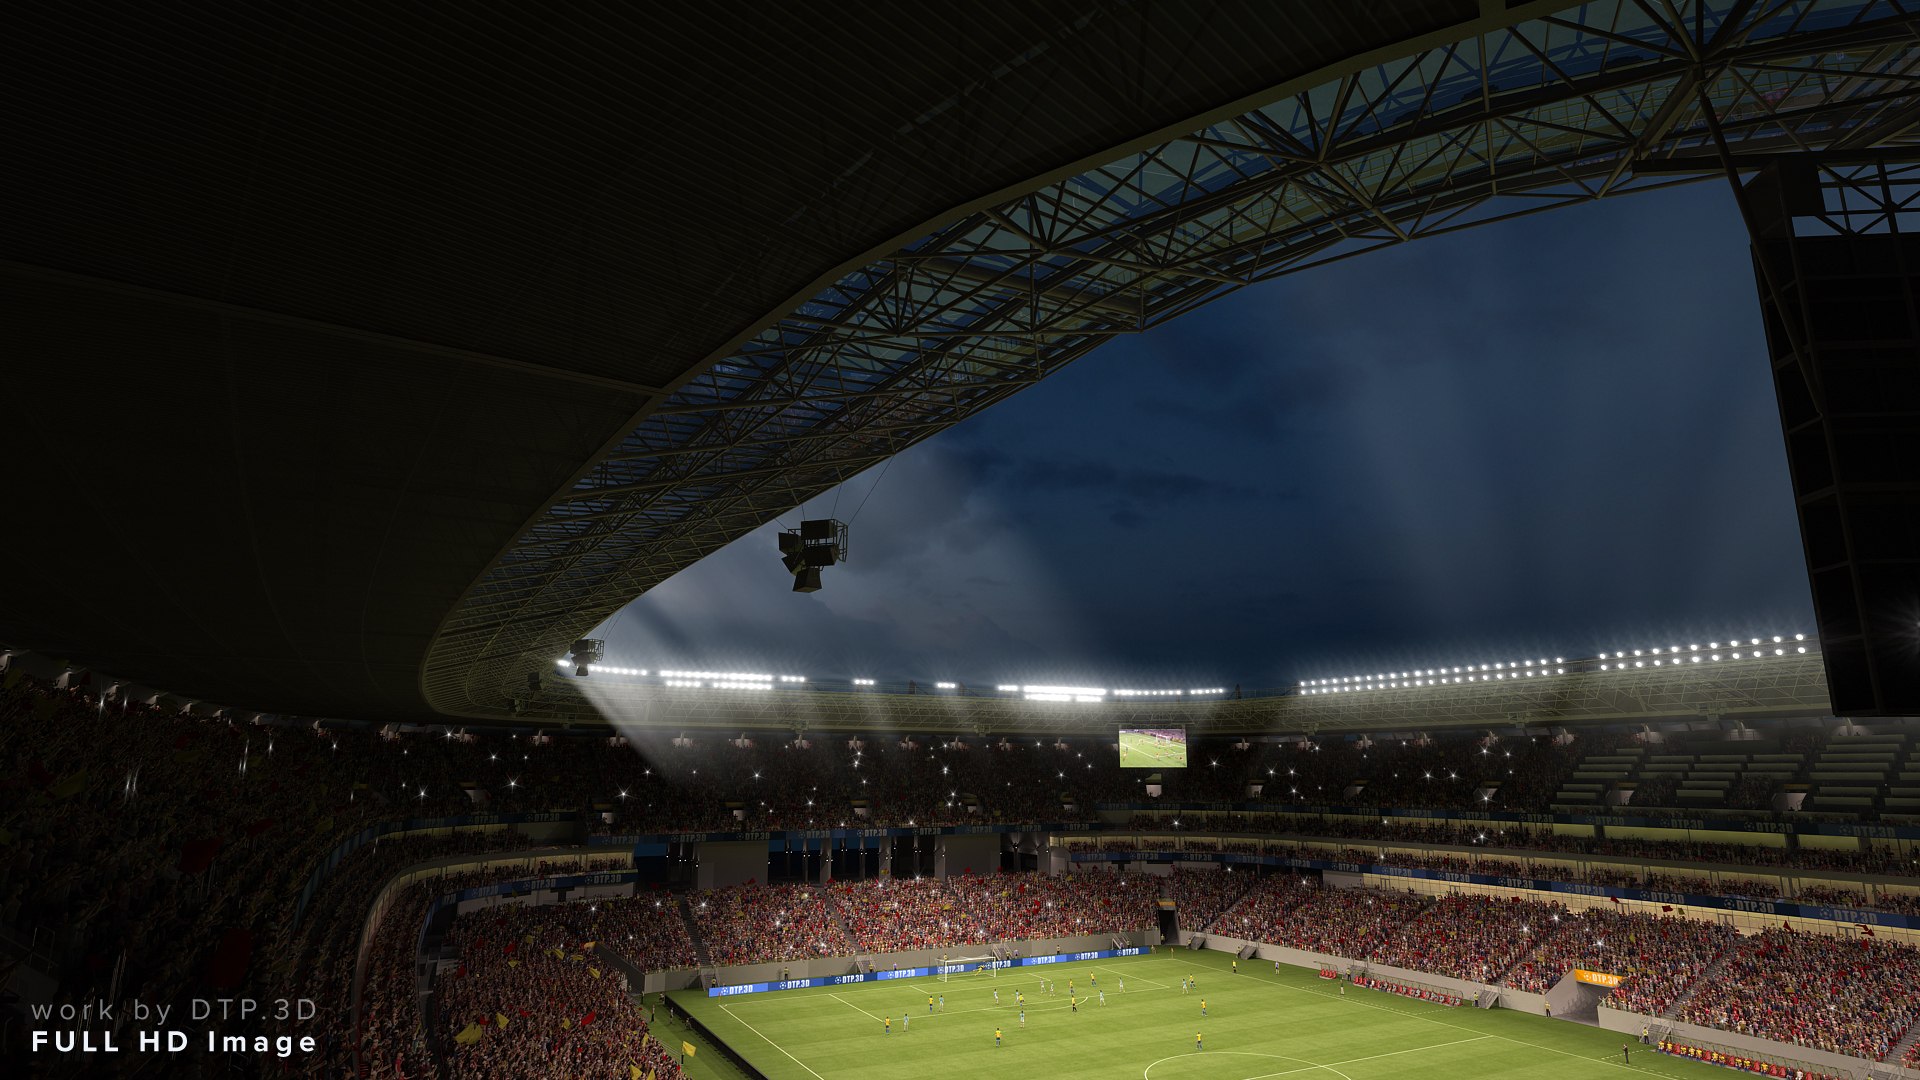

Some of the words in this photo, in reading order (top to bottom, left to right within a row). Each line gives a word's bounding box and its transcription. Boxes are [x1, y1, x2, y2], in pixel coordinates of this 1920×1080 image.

[1038, 956, 1055, 964] DTP.3D
[1081, 952, 1098, 960] DTP.3D
[945, 964, 964, 973] DTP.3D
[990, 960, 1011, 969] DTP.3D
[894, 969, 915, 978] DTP.3D
[842, 974, 864, 984] DTP.3D
[787, 980, 810, 989] DTP.3D
[729, 985, 753, 994] DTP.3D
